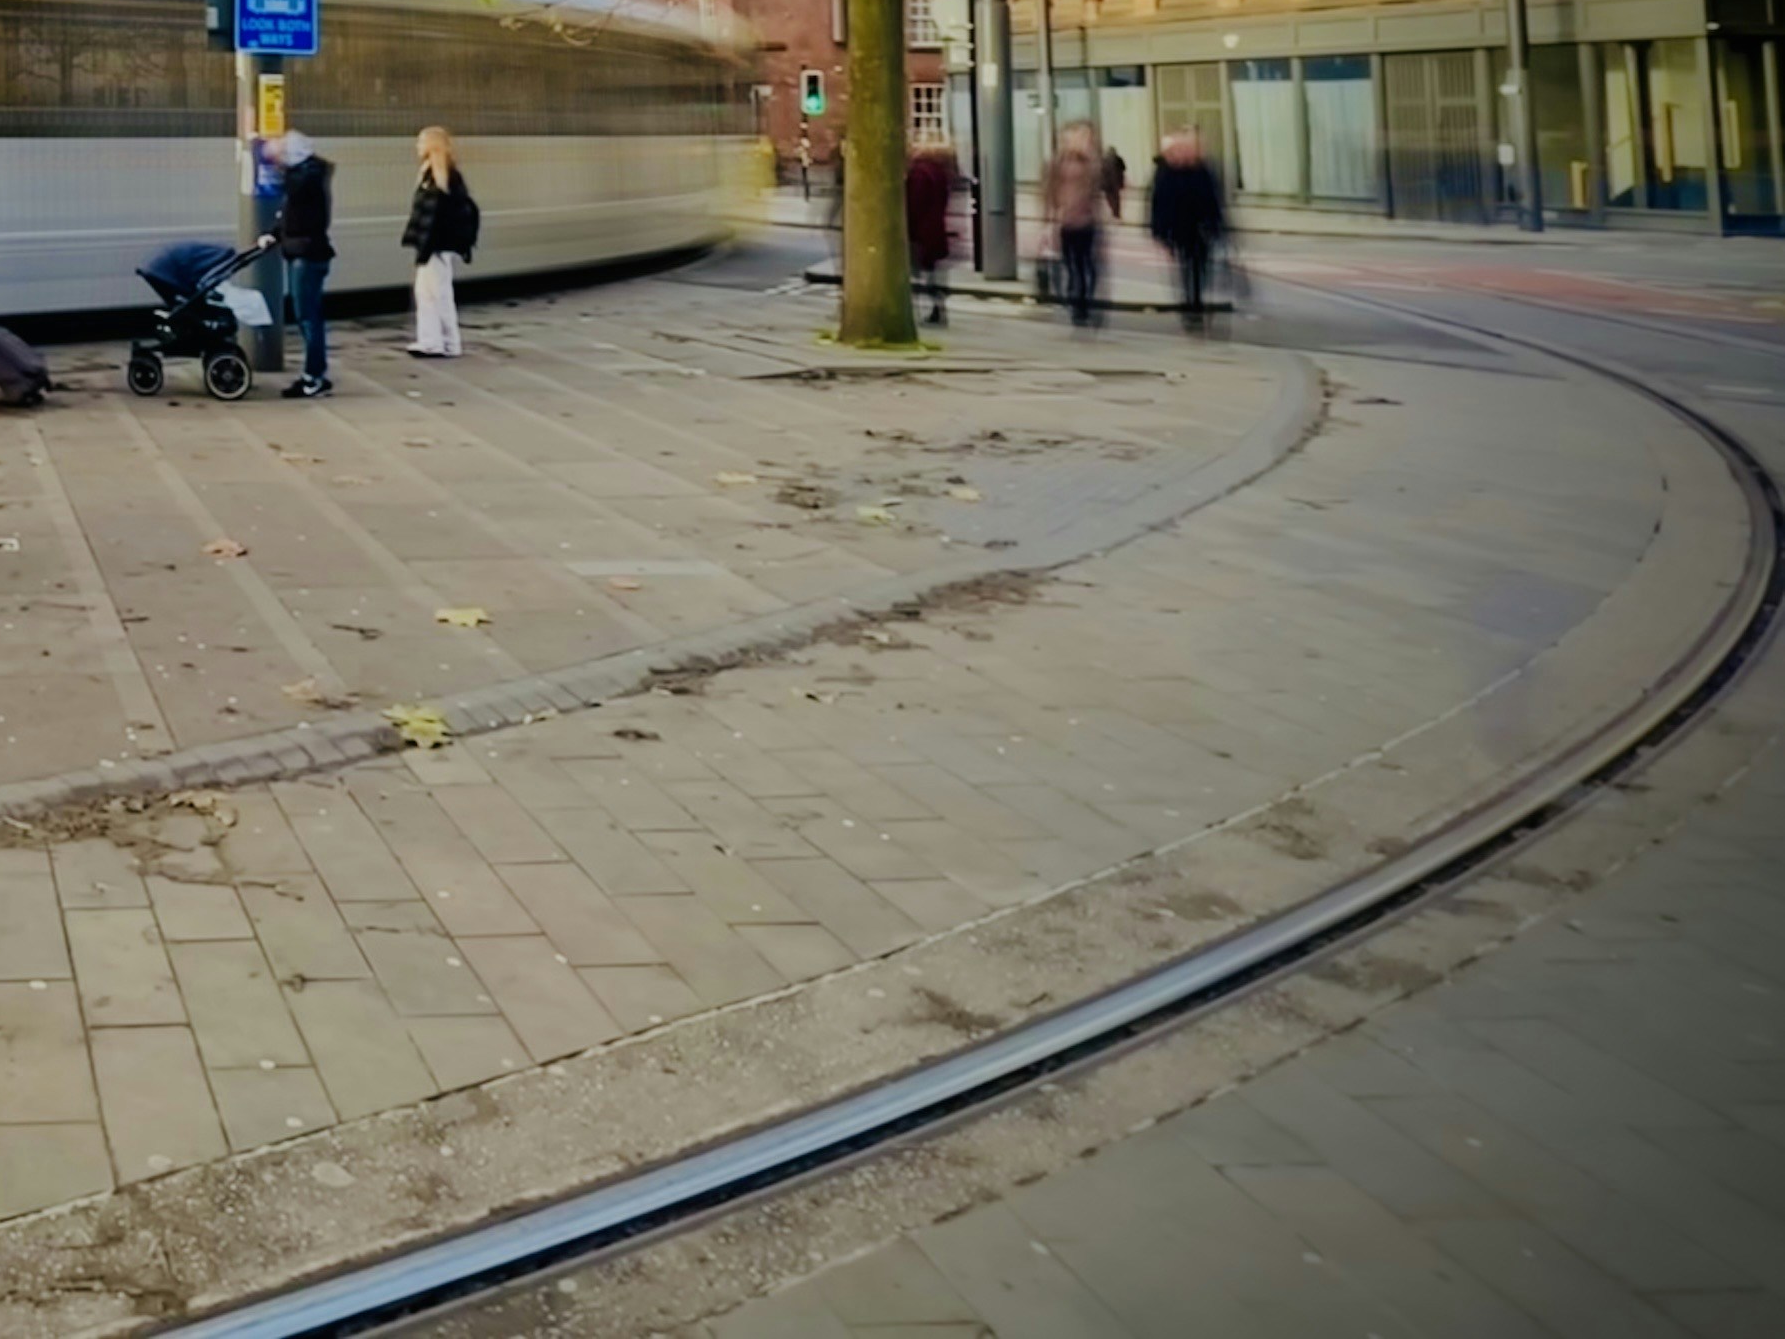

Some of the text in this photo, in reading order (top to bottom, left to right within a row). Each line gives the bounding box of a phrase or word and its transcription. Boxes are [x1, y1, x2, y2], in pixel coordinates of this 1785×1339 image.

[242, 17, 311, 32] LOOK BOTH
[259, 33, 294, 47] WAYS
